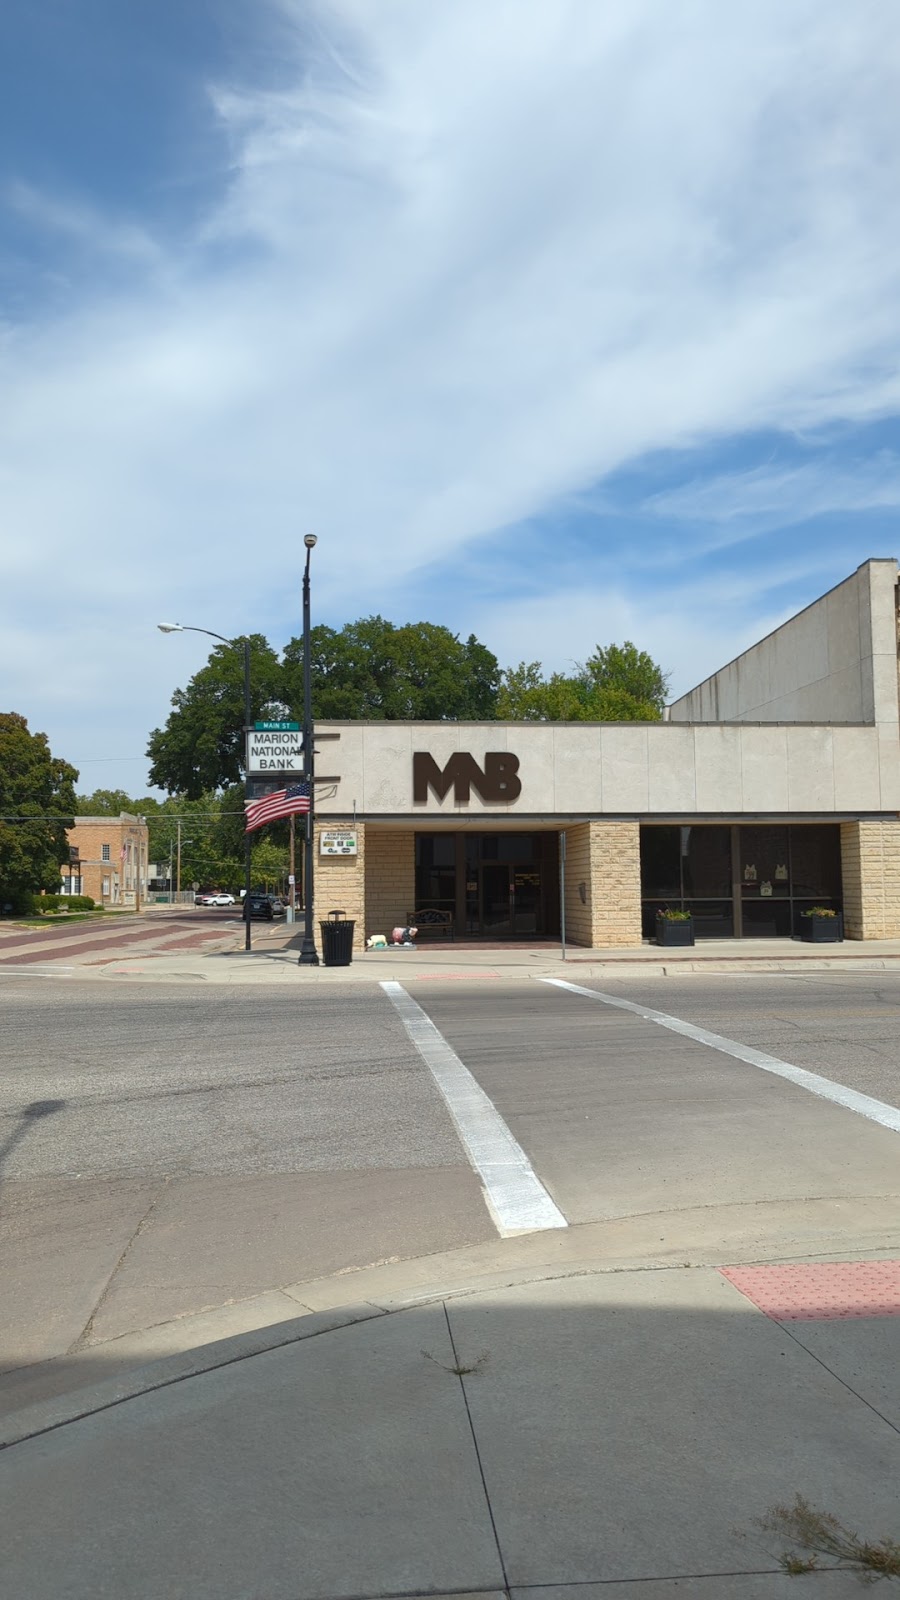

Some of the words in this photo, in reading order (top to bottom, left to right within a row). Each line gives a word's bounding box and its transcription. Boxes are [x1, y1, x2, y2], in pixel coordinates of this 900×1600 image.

[254, 734, 298, 744] MARION
[260, 759, 295, 769] BANK
[413, 752, 522, 802] MNB
